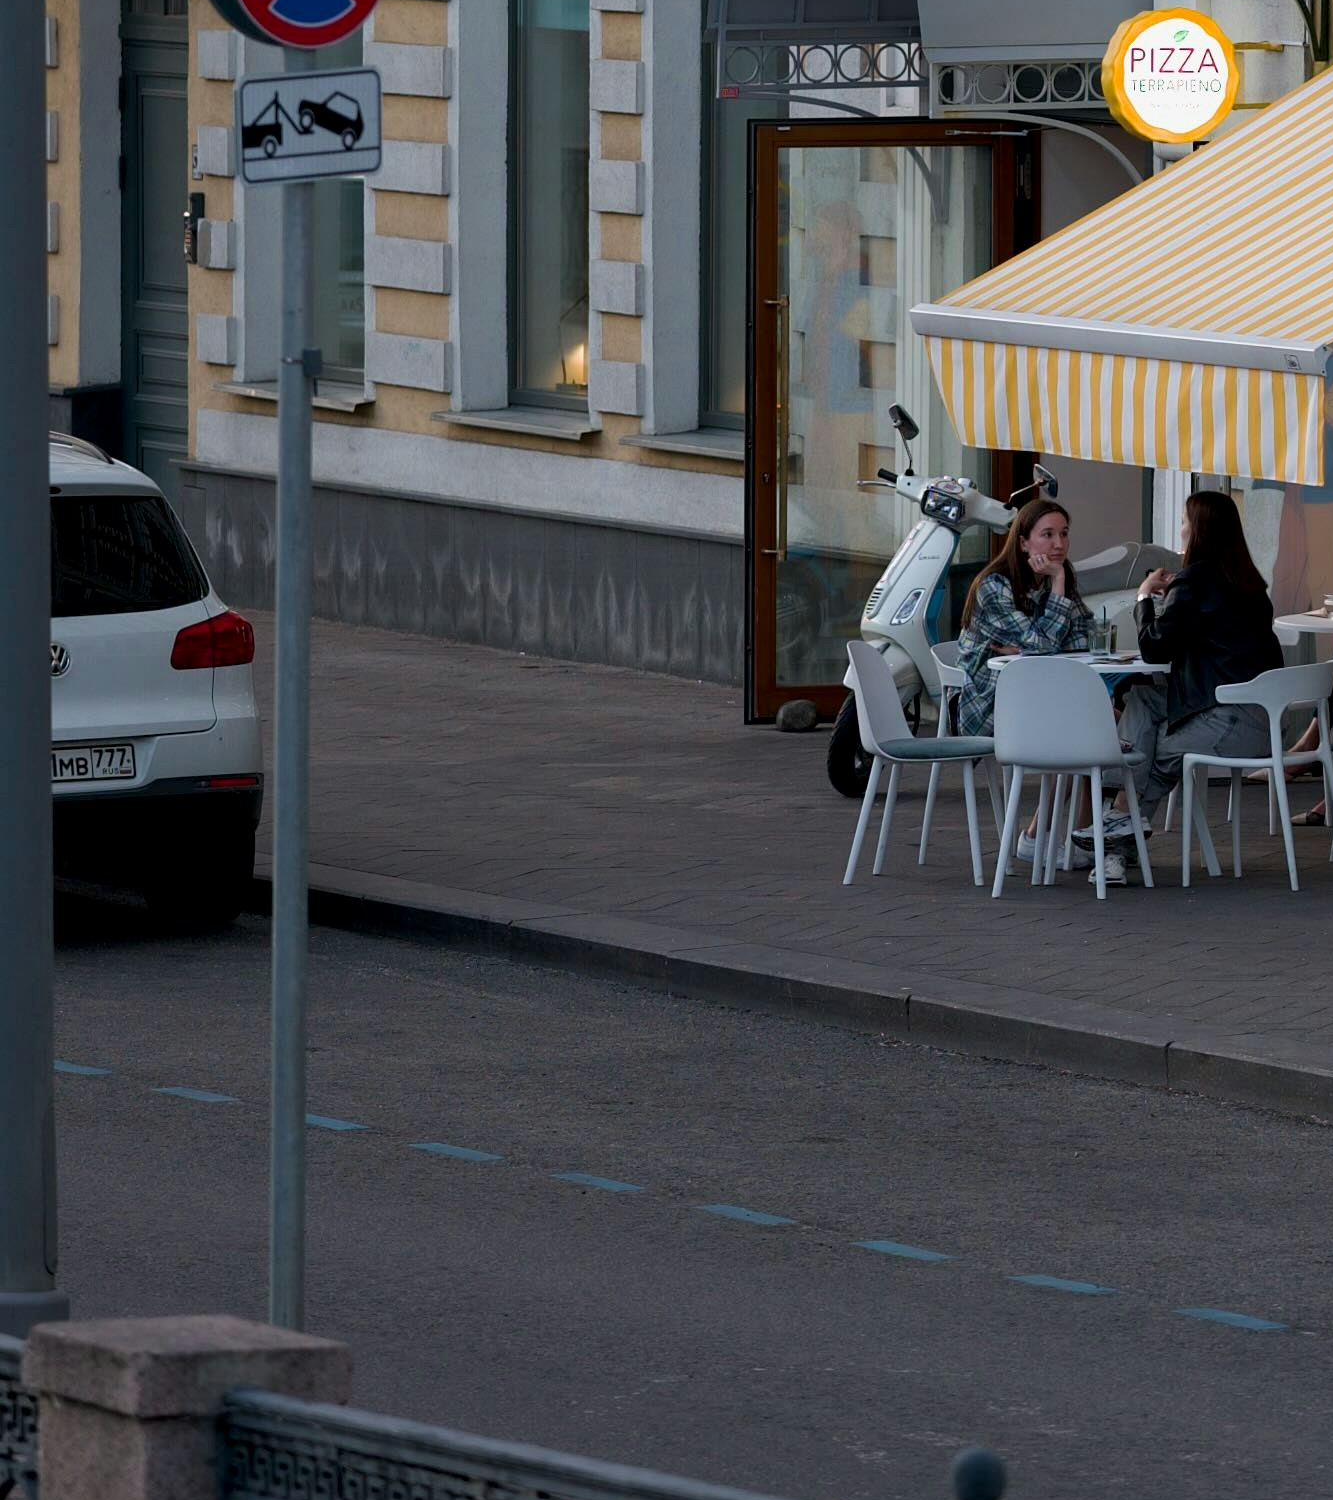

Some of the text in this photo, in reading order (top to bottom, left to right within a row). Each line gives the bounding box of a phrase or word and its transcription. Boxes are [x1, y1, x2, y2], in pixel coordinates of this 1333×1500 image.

[1130, 47, 1219, 73] PIZZA
[1131, 79, 1222, 93] TERRAPIENO
[93, 749, 126, 767] 777
[102, 767, 119, 775] RUS
